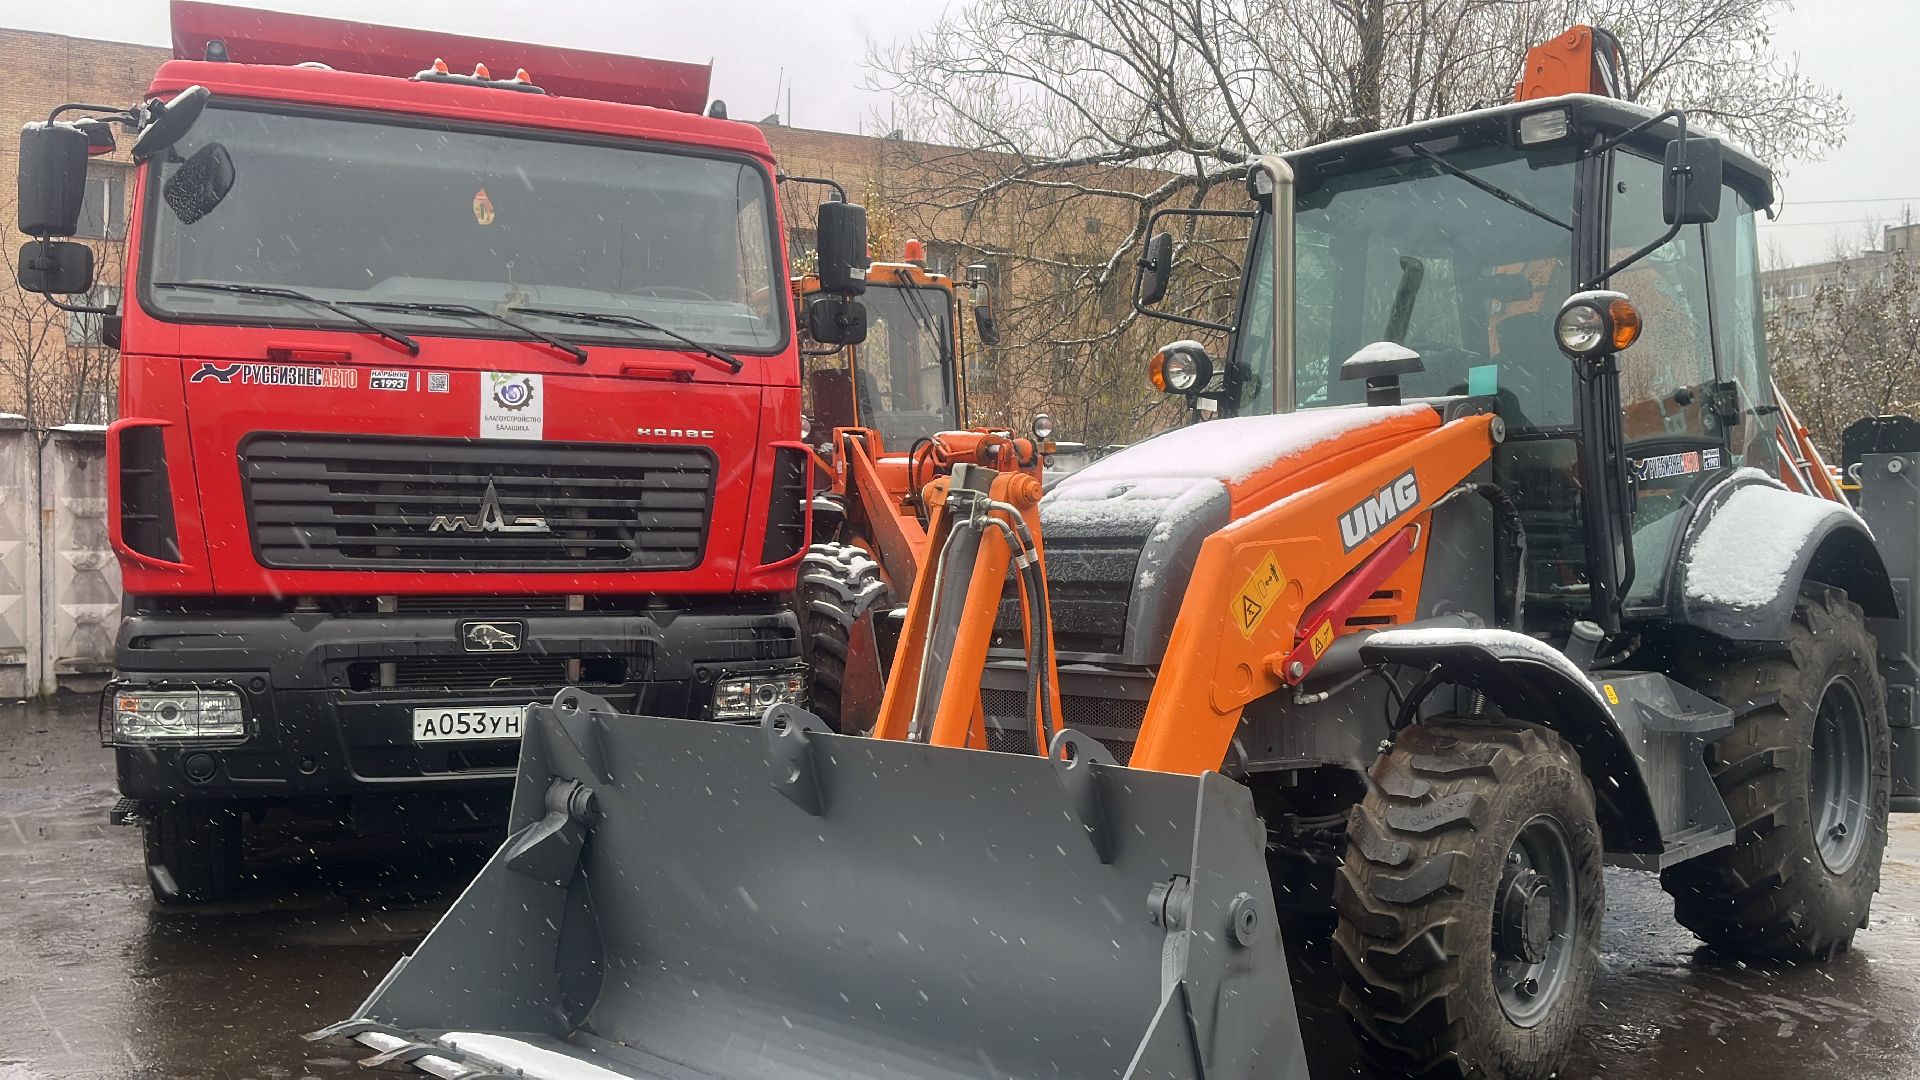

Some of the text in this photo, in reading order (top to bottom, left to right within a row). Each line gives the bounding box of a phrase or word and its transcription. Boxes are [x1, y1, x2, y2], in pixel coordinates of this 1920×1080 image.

[243, 364, 357, 388] РУСБИЗНЕСАВТО
[485, 415, 541, 423] БЛАГОУСТРОЙСТВО
[496, 424, 529, 432] БАЛАШИХА
[1340, 473, 1417, 547] UMG
[423, 712, 519, 736] А053УН
